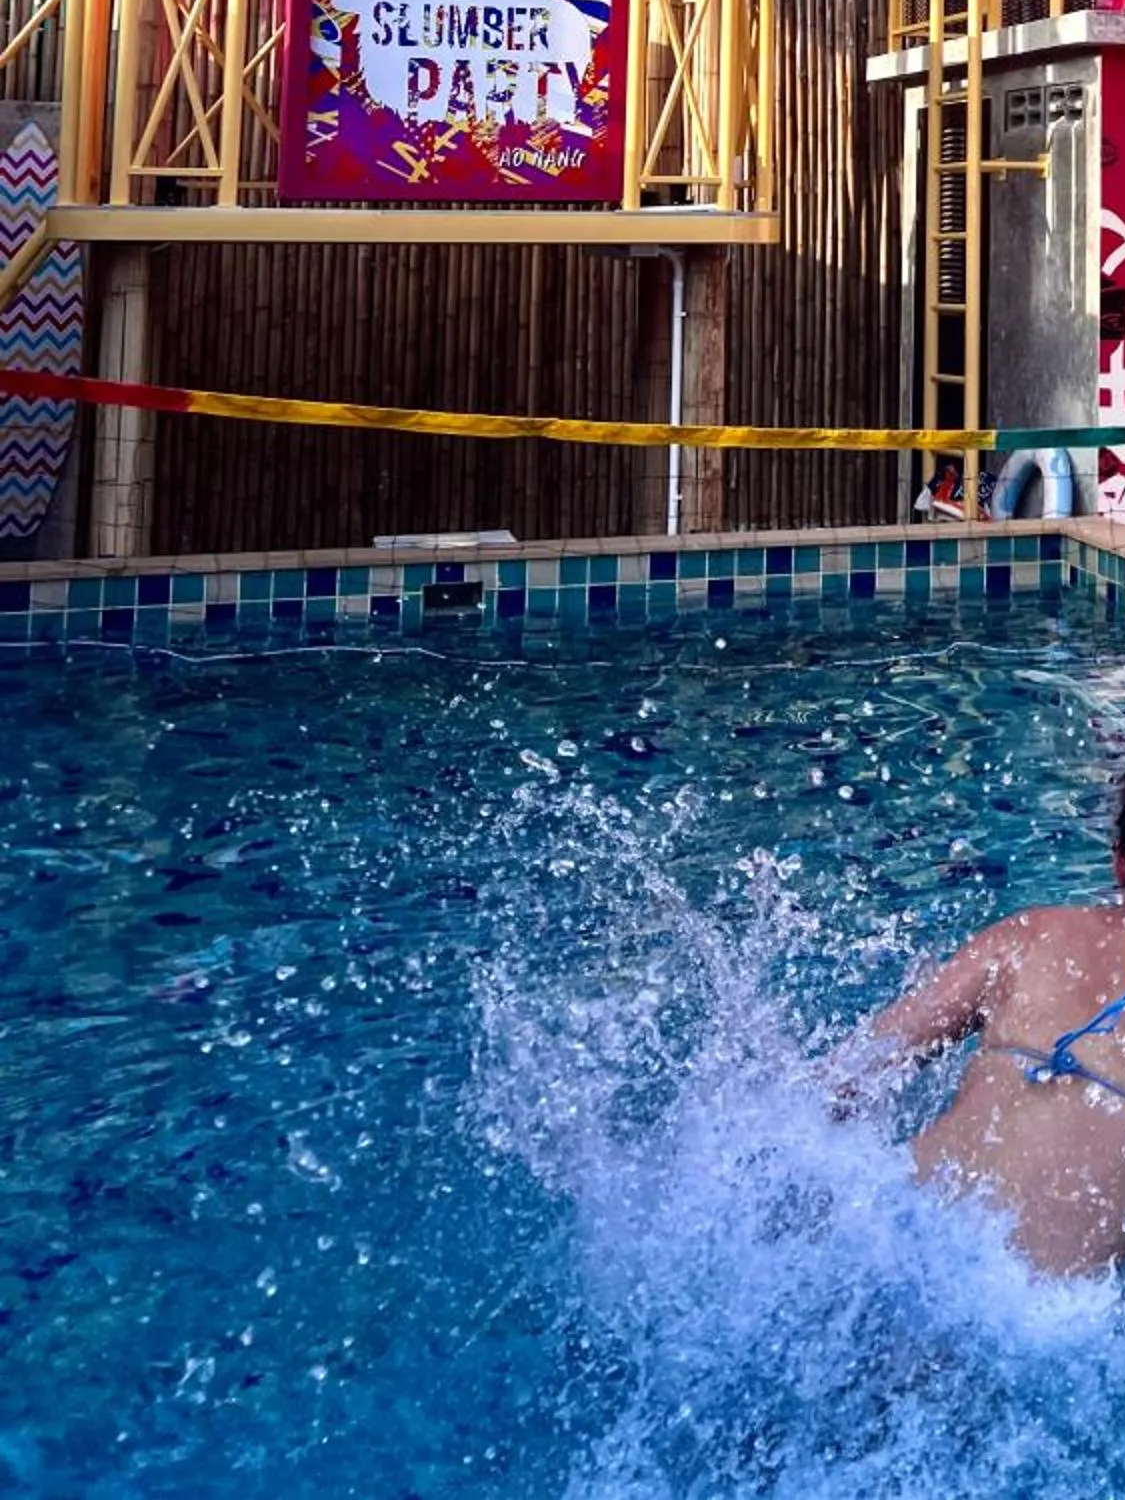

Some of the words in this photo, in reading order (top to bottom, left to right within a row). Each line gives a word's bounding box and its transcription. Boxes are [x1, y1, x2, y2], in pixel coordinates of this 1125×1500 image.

[372, 1, 551, 51] SLUMBER
[408, 57, 604, 129] PARTY
[499, 147, 528, 168] AO
[531, 147, 587, 169] NANG
